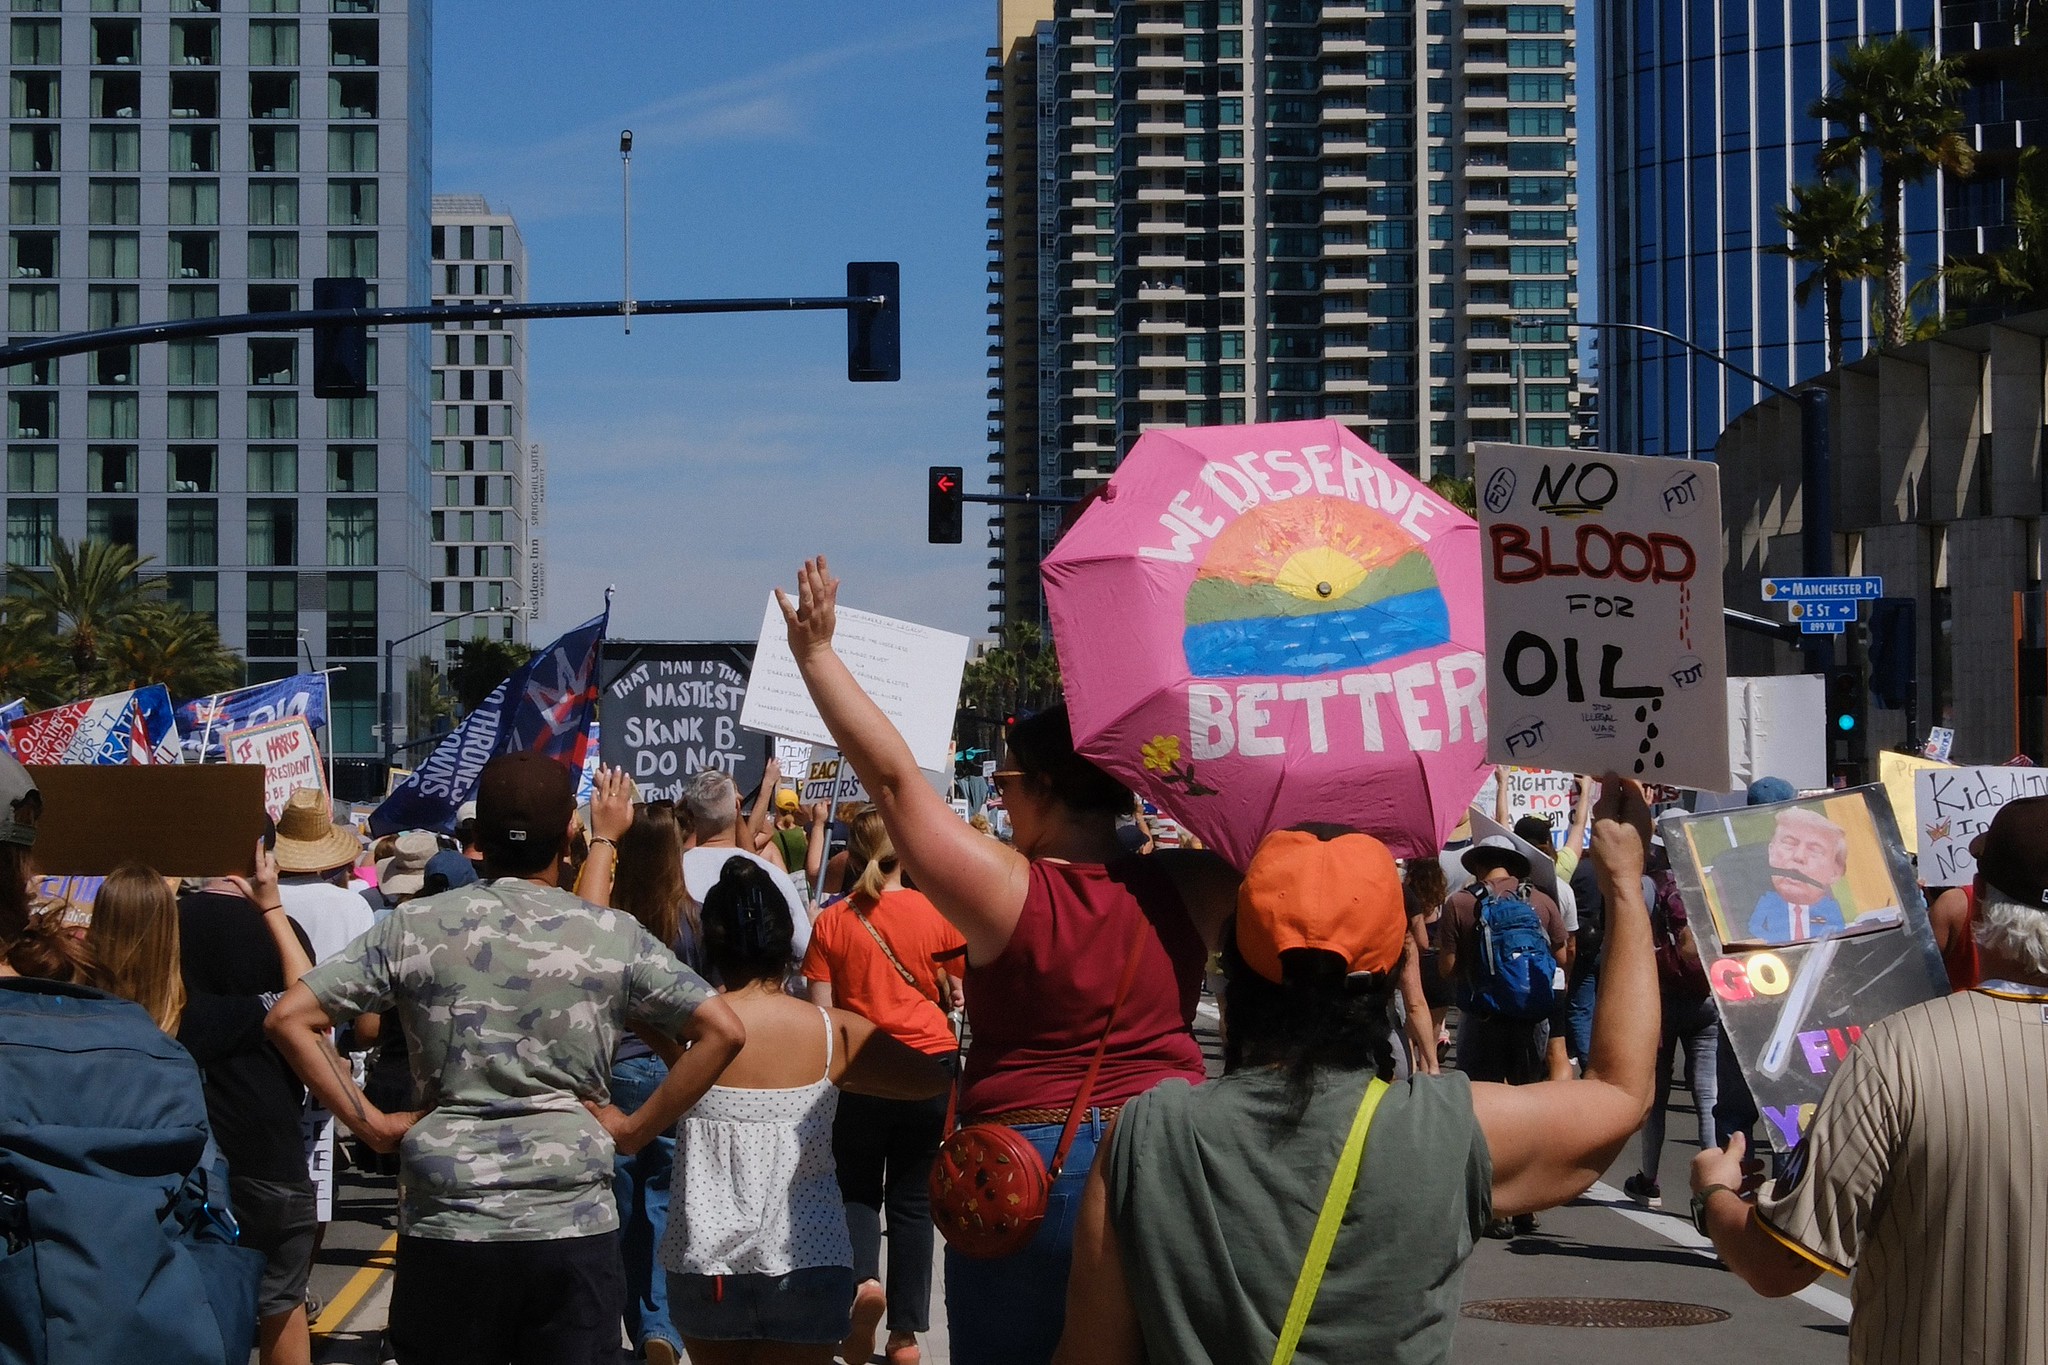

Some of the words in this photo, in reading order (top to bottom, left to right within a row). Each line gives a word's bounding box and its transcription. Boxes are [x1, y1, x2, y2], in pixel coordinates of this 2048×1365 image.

[1532, 462, 1618, 505] NO
[1663, 473, 1696, 512] FDT
[1139, 490, 1225, 562] WE
[1200, 445, 1450, 542] DESERVE
[530, 539, 538, 559] Inn
[1490, 524, 1697, 584] BLOOD
[530, 562, 538, 620] Residence
[1566, 594, 1634, 618] FOR
[1806, 604, 1813, 617] E
[1810, 622, 1825, 631] 899
[1826, 622, 1835, 631] W
[612, 664, 650, 699] THAT
[660, 661, 693, 676] MAN
[701, 661, 713, 675] IS
[718, 663, 742, 685] THE
[1503, 630, 1664, 702] OIL
[1671, 663, 1703, 688] FDT
[646, 681, 745, 711] NASTIEST
[1188, 650, 1487, 760] BETTER
[71, 704, 86, 724] IT
[1590, 724, 1617, 733] WAR
[19, 716, 48, 754] OUR
[79, 737, 101, 763] FOR
[96, 708, 117, 732] IT
[237, 738, 253, 763] IF
[266, 730, 299, 763] HARRIS
[624, 716, 703, 748] SKANK
[715, 716, 743, 749] B.
[1505, 720, 1545, 757] FDT
[265, 755, 310, 784] PRESIDENT
[636, 750, 677, 776] DO
[686, 746, 746, 779] NOT
[273, 786, 285, 800] BE
[805, 775, 860, 799] OTHR'S
[1507, 775, 1568, 791] RIGHTS
[1512, 793, 1526, 806] is
[1529, 788, 1578, 809] not
[1929, 770, 2004, 820] Kids
[1710, 953, 1790, 1000] GO
